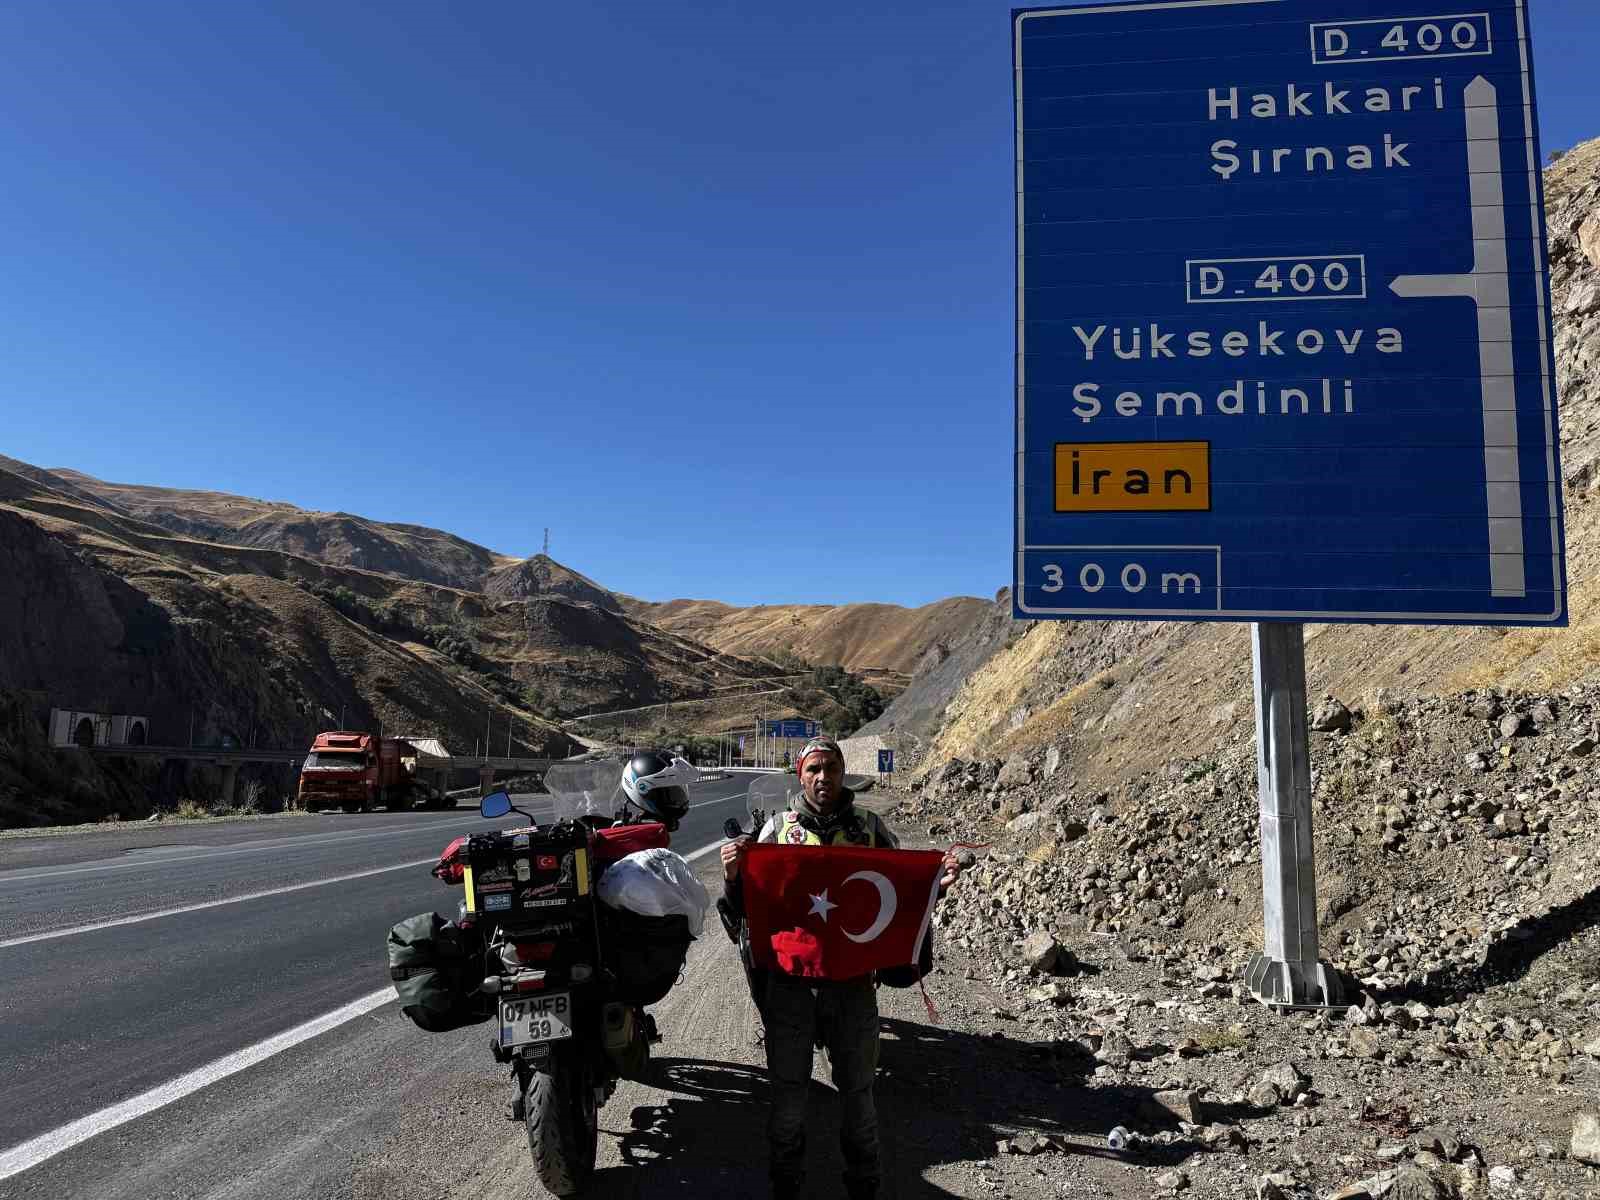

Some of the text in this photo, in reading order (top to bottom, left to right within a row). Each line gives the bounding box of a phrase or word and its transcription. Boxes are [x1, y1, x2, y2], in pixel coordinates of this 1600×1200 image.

[1208, 77, 1445, 121] Hakkari
[1210, 134, 1411, 180] Şırnak
[1071, 320, 1403, 361] Yüksekova
[1071, 378, 1354, 423] Şemdinli
[1071, 451, 1193, 495] İran
[529, 1019, 552, 1039] 59
